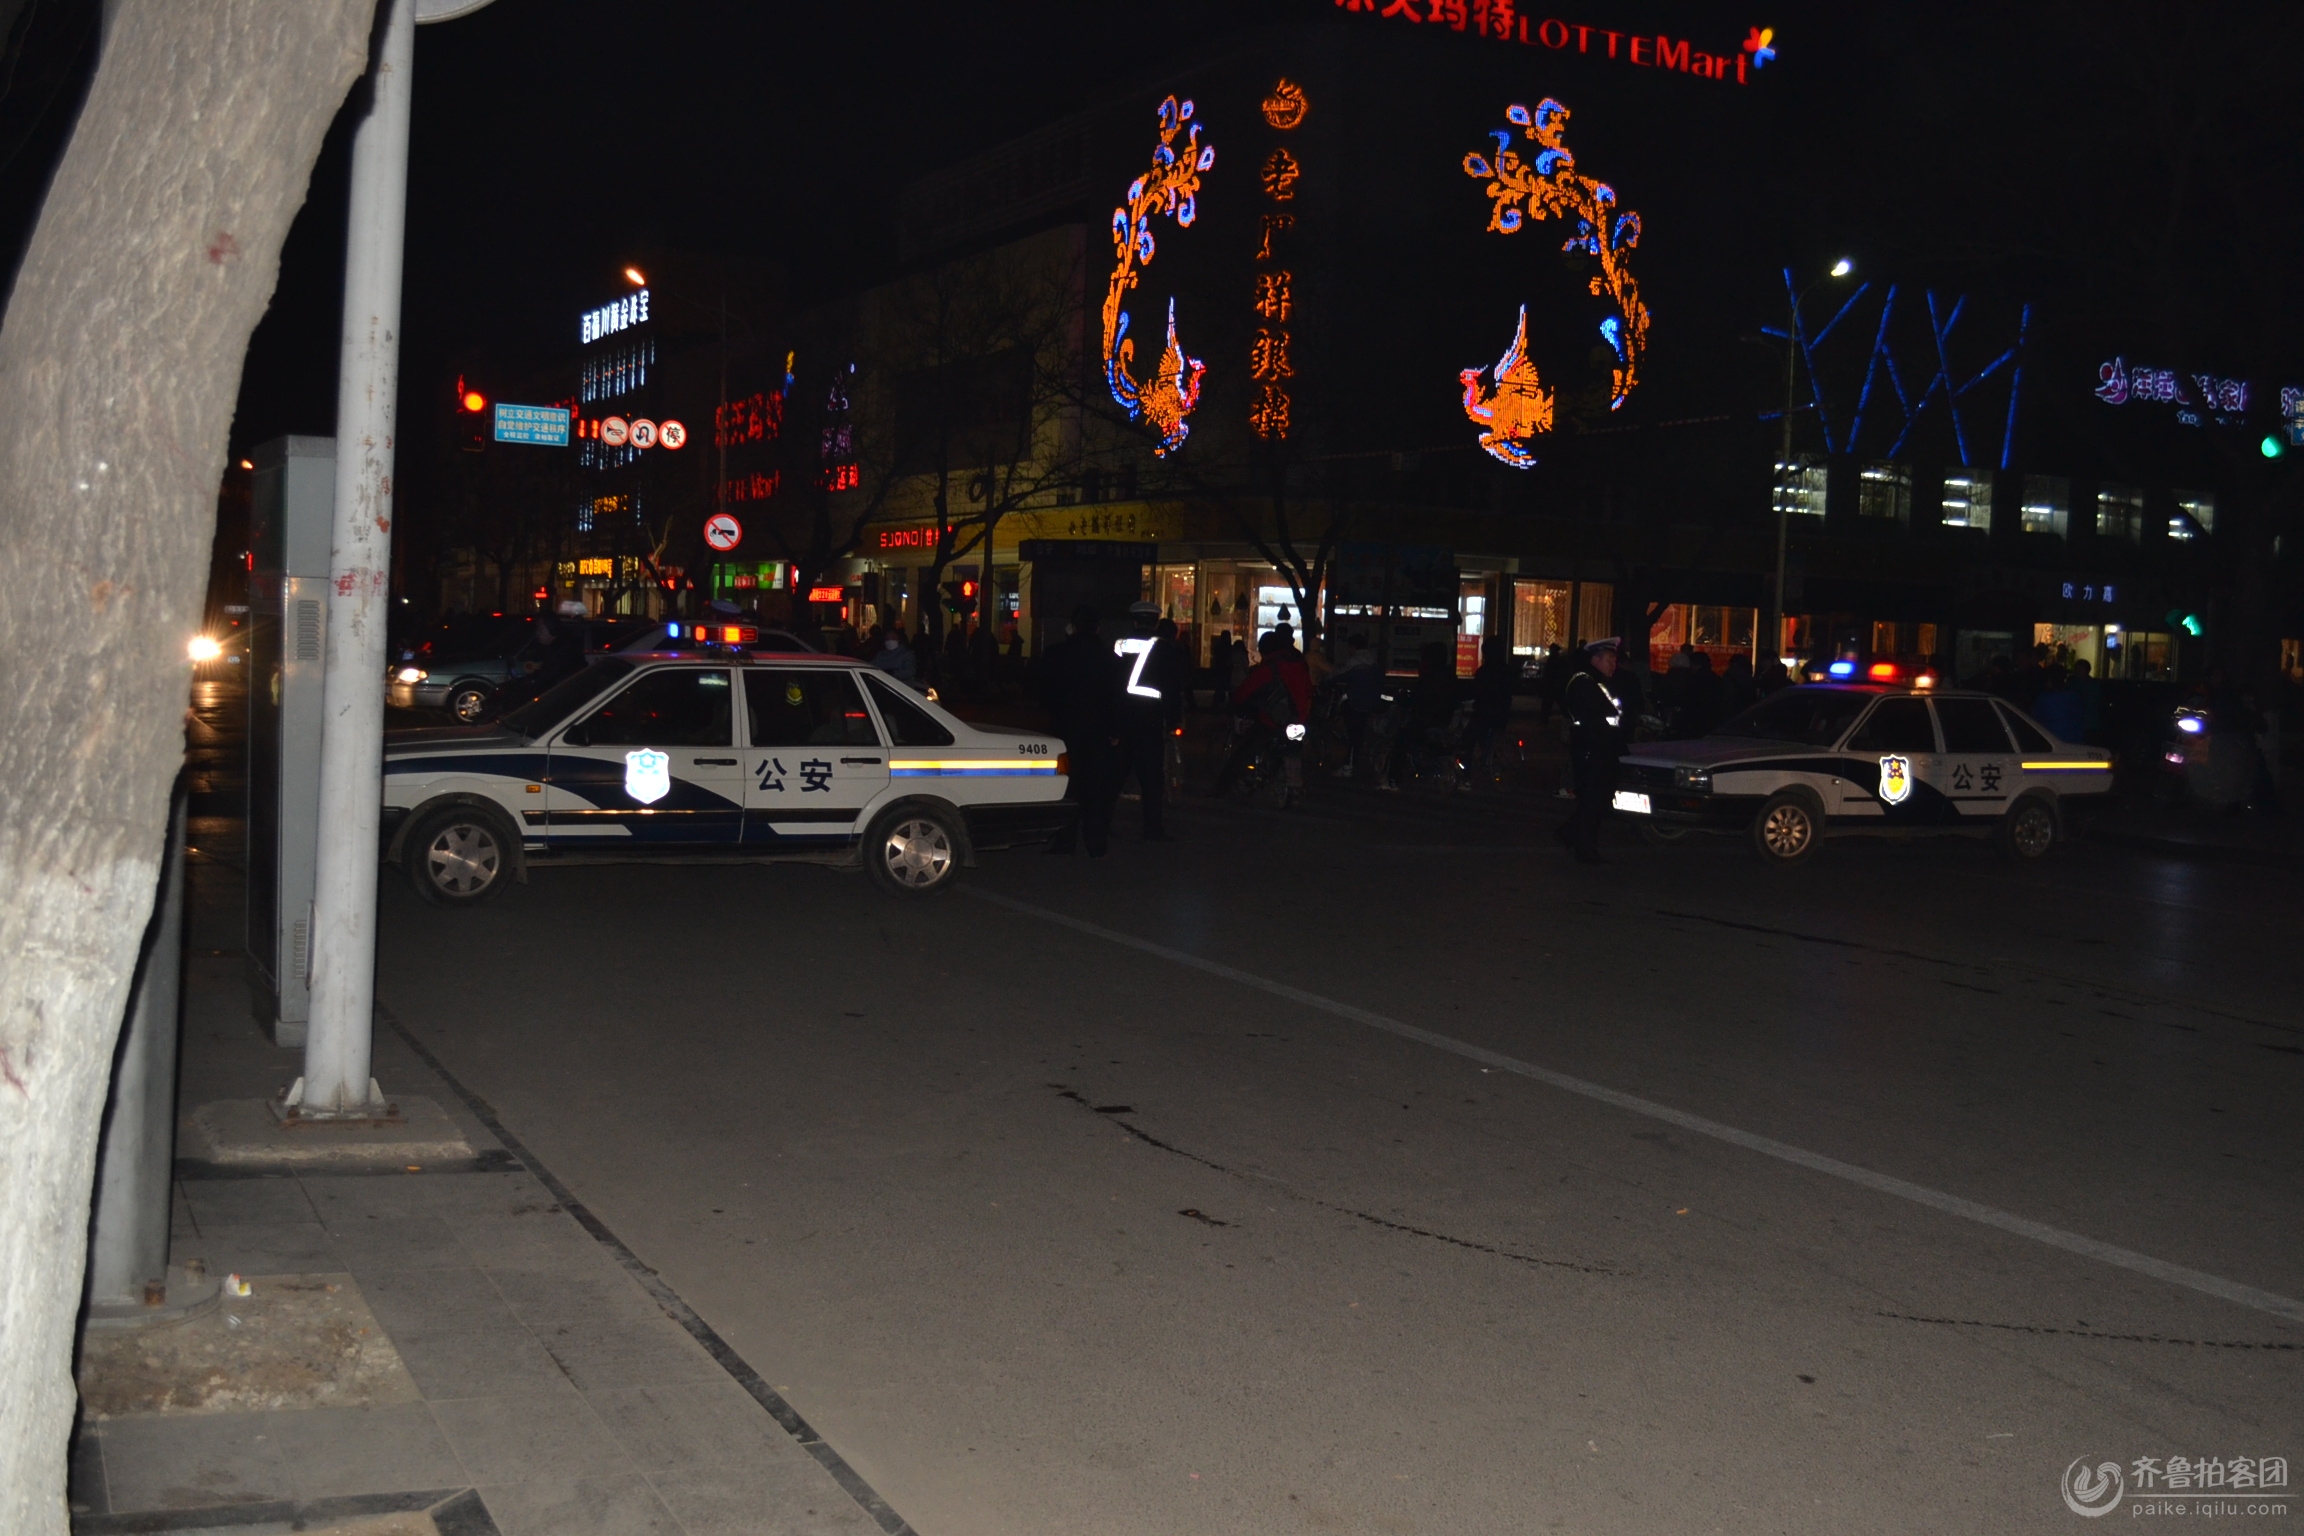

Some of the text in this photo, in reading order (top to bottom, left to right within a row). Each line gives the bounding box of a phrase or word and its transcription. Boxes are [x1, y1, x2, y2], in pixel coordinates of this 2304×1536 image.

[666, 425, 681, 444] 停
[1018, 744, 1048, 755] 9408
[755, 757, 834, 793] 公安
[1952, 763, 2002, 792] 公安
